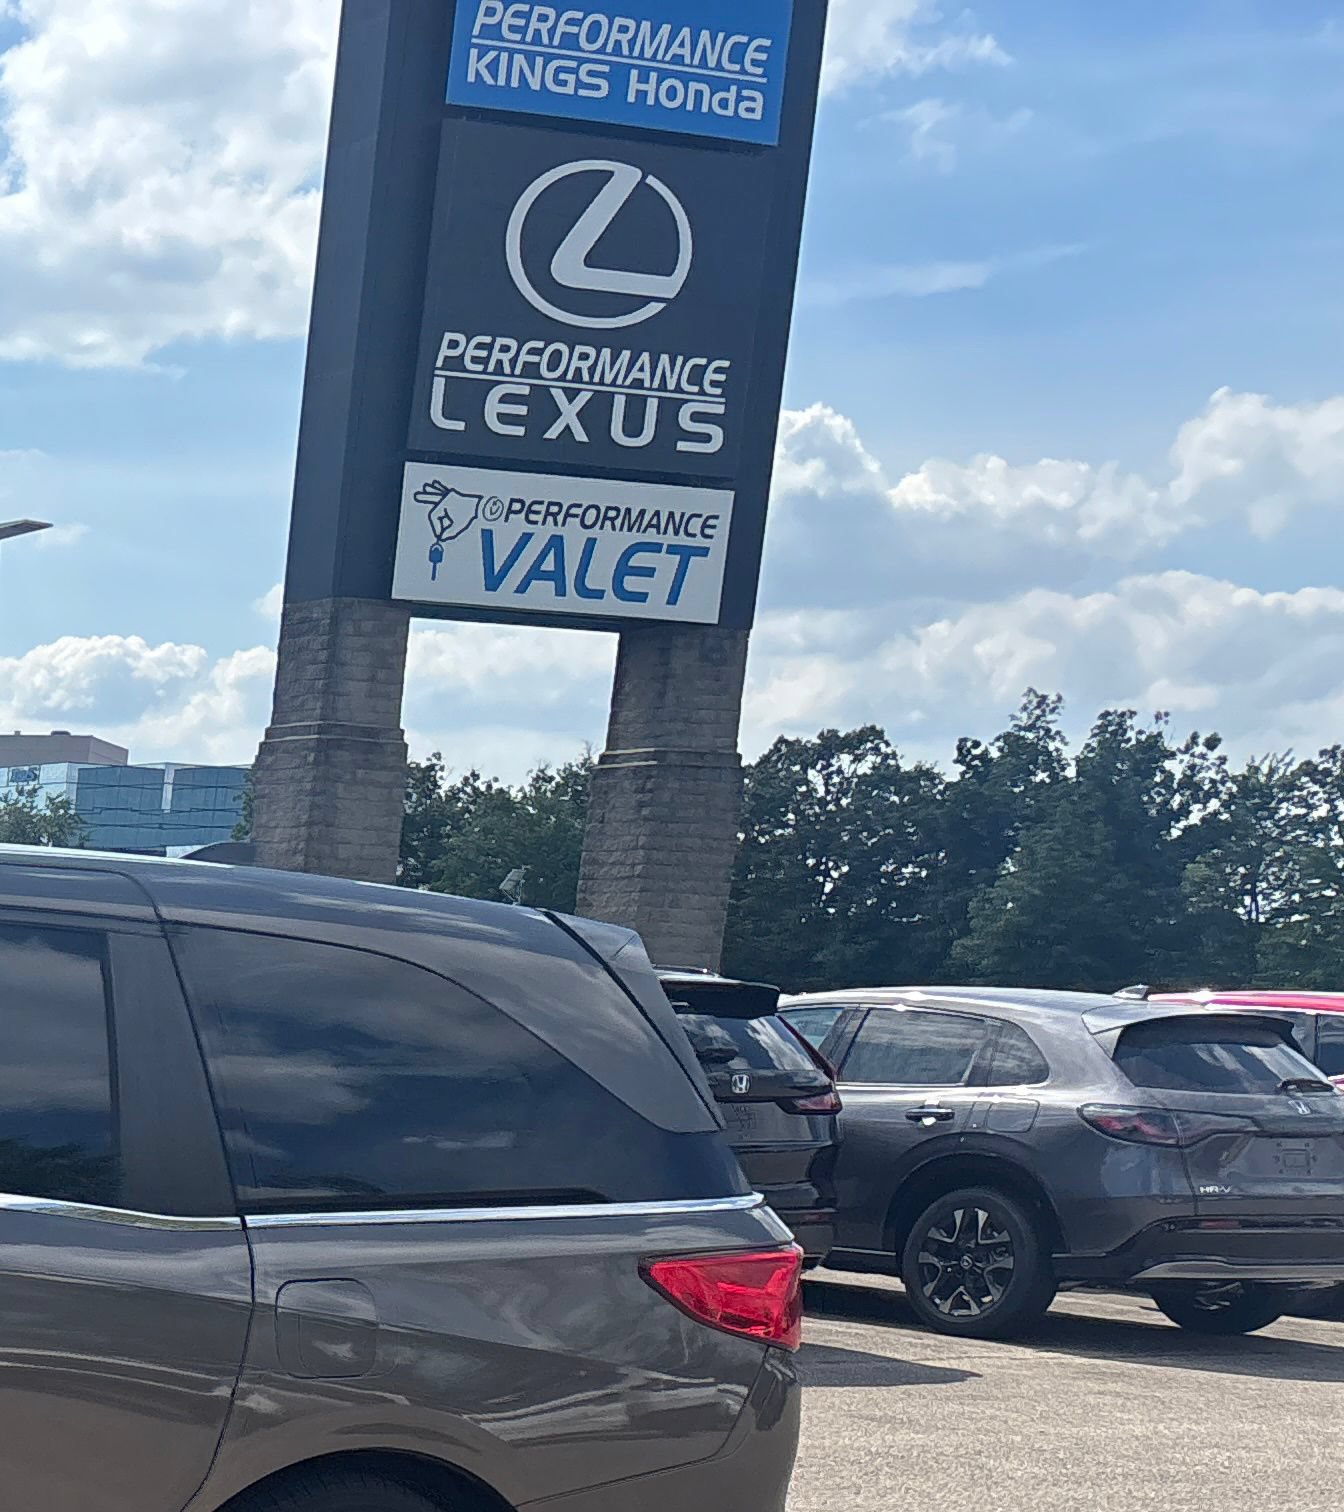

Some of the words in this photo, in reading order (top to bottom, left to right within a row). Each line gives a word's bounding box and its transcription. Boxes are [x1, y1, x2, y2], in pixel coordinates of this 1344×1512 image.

[472, 0, 772, 75] PERFORMANCE
[466, 47, 611, 98] KINGS
[627, 69, 764, 121] Honda
[435, 331, 731, 395] PERFORMANCE
[430, 376, 726, 454] LEXUS
[503, 497, 721, 540] PERFORMANCE
[480, 528, 711, 607] VALET
